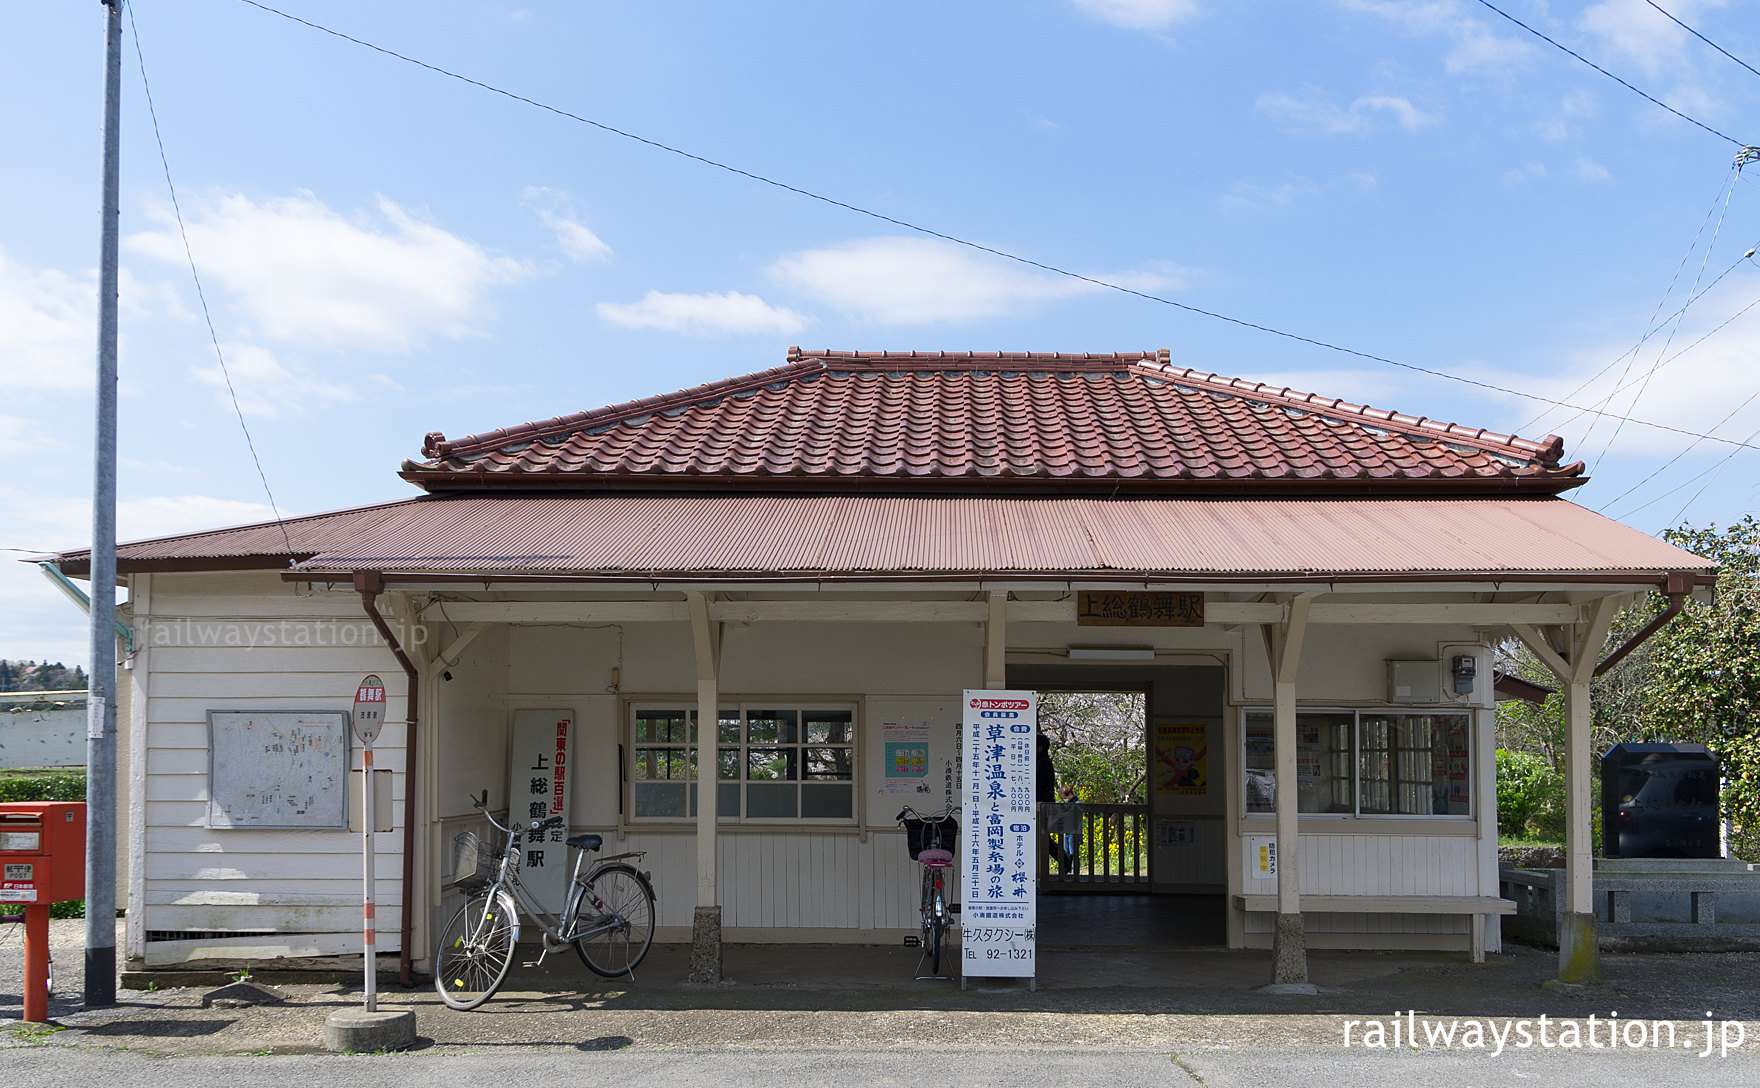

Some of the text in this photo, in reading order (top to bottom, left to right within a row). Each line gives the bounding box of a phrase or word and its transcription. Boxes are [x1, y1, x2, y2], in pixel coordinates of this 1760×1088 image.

[1079, 593, 1203, 620] 上総鶴舞駅
[526, 753, 549, 868] 上総鶴舞駅
[984, 723, 1007, 899] 草津温泉と富岡製糸場の旅
[1268, 842, 1276, 874] 防犯カメラ
[986, 949, 1032, 960] 92-1321
